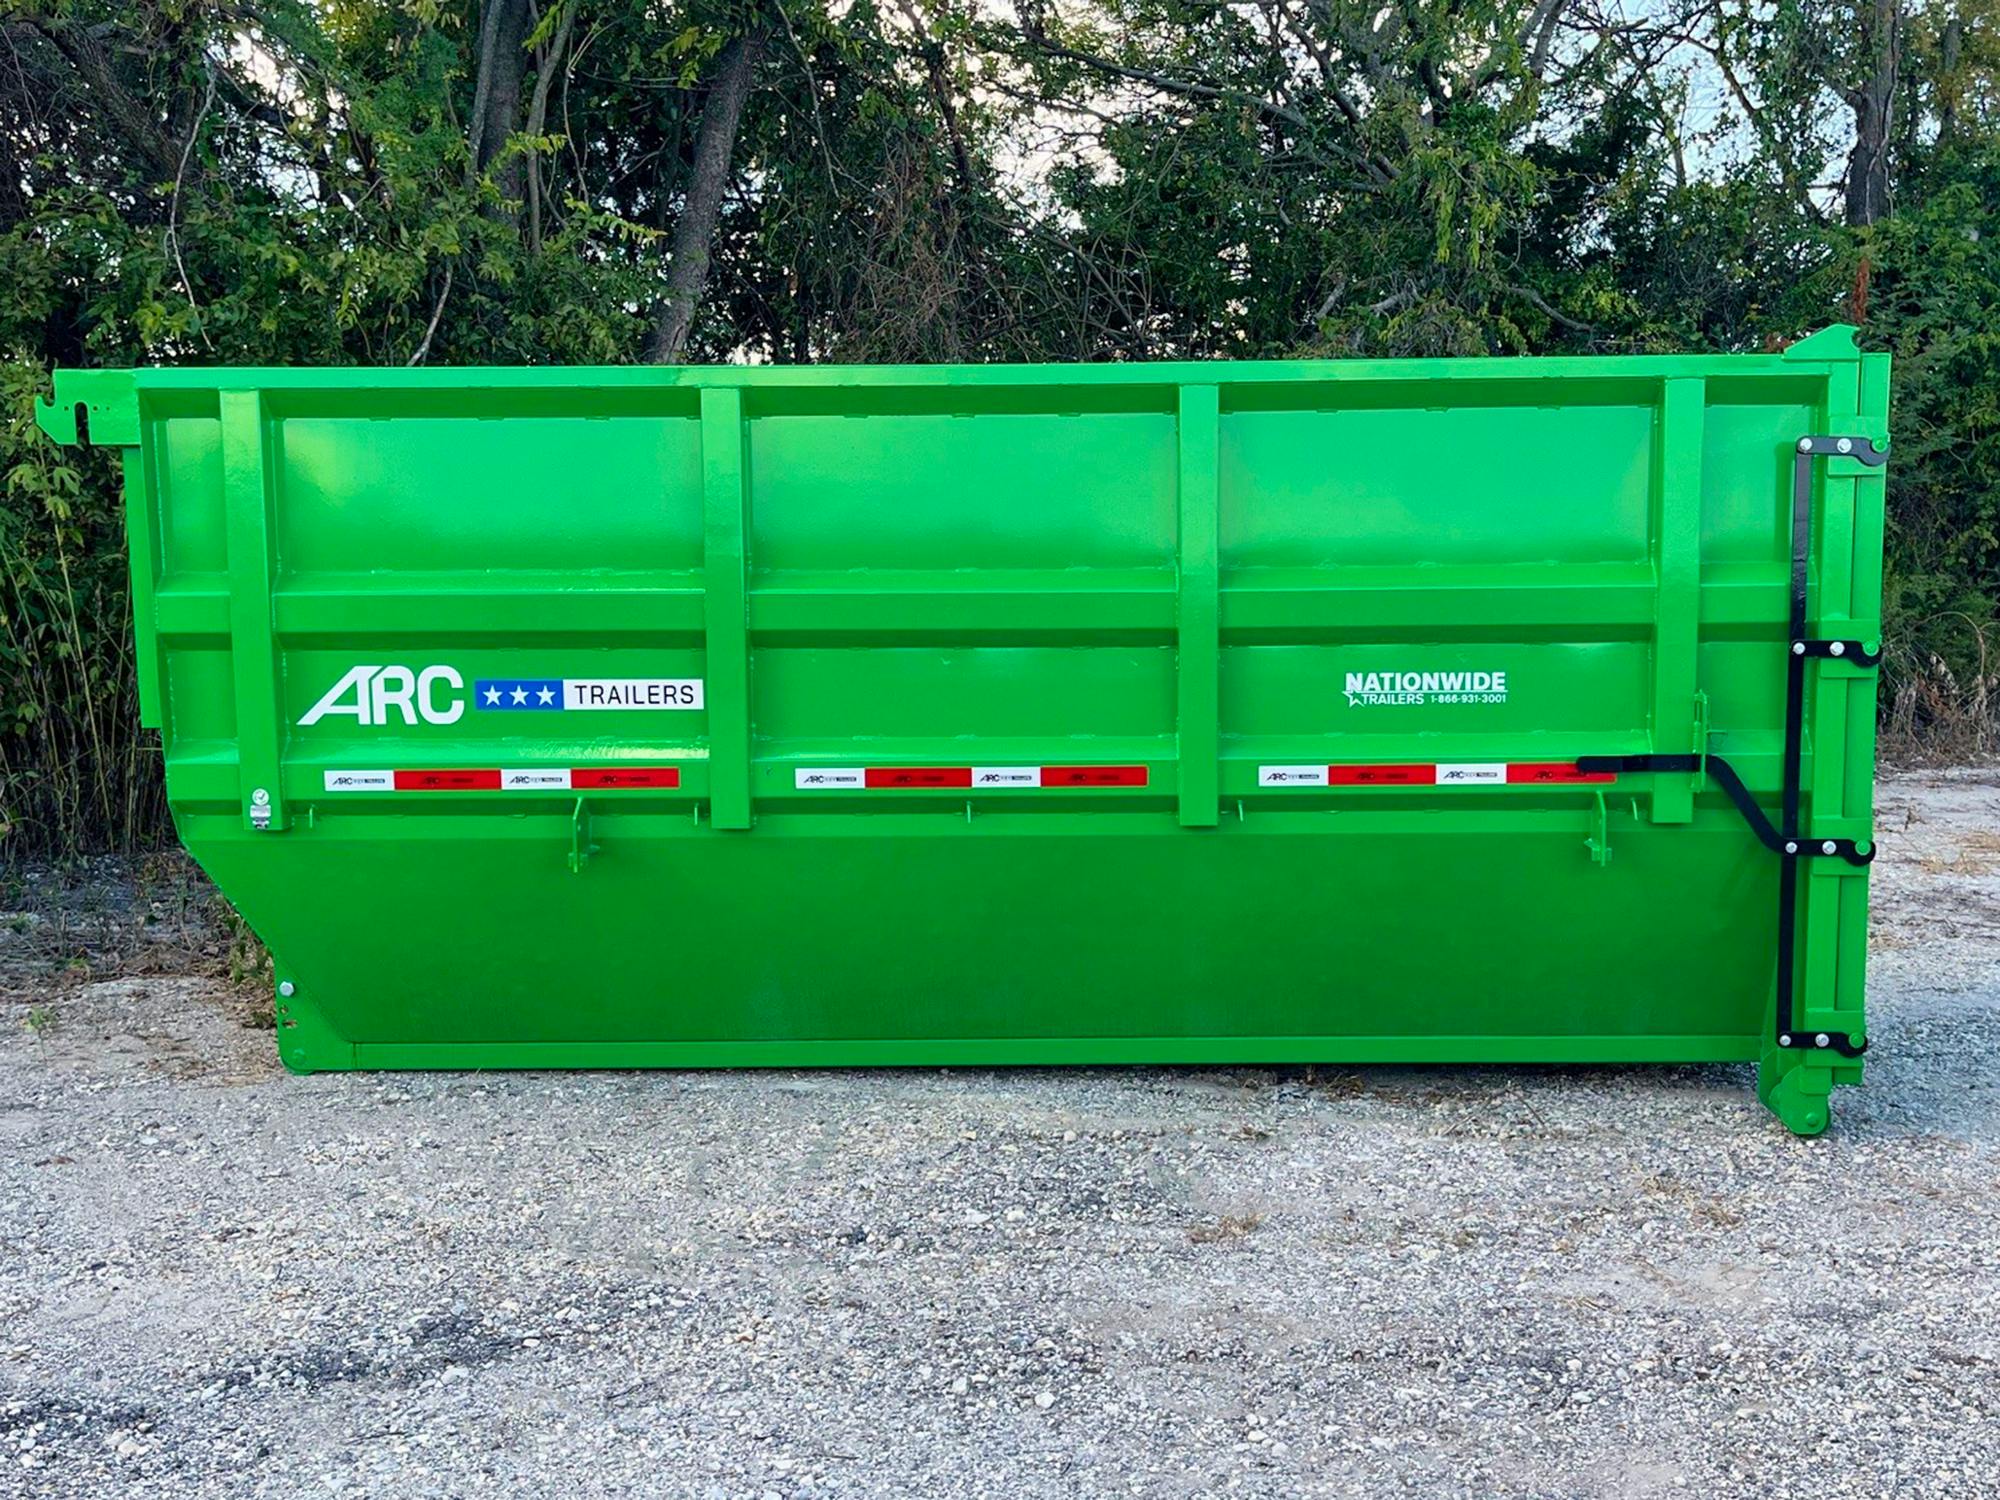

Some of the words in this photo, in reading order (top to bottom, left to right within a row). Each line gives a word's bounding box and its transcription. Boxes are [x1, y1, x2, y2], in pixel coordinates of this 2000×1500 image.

[1345, 672, 1506, 691] NATIONWIDE
[296, 664, 465, 726] ARC
[574, 684, 695, 705] TRAILERS
[1361, 693, 1425, 705] TRAILERS
[1430, 694, 1507, 704] 1-866-931-3001
[803, 775, 824, 783] ARC
[979, 774, 1000, 782] ARC
[1266, 773, 1287, 781] ARC
[1443, 771, 1464, 780] ARC
[332, 777, 353, 785] ARC
[509, 776, 530, 784] ARC
